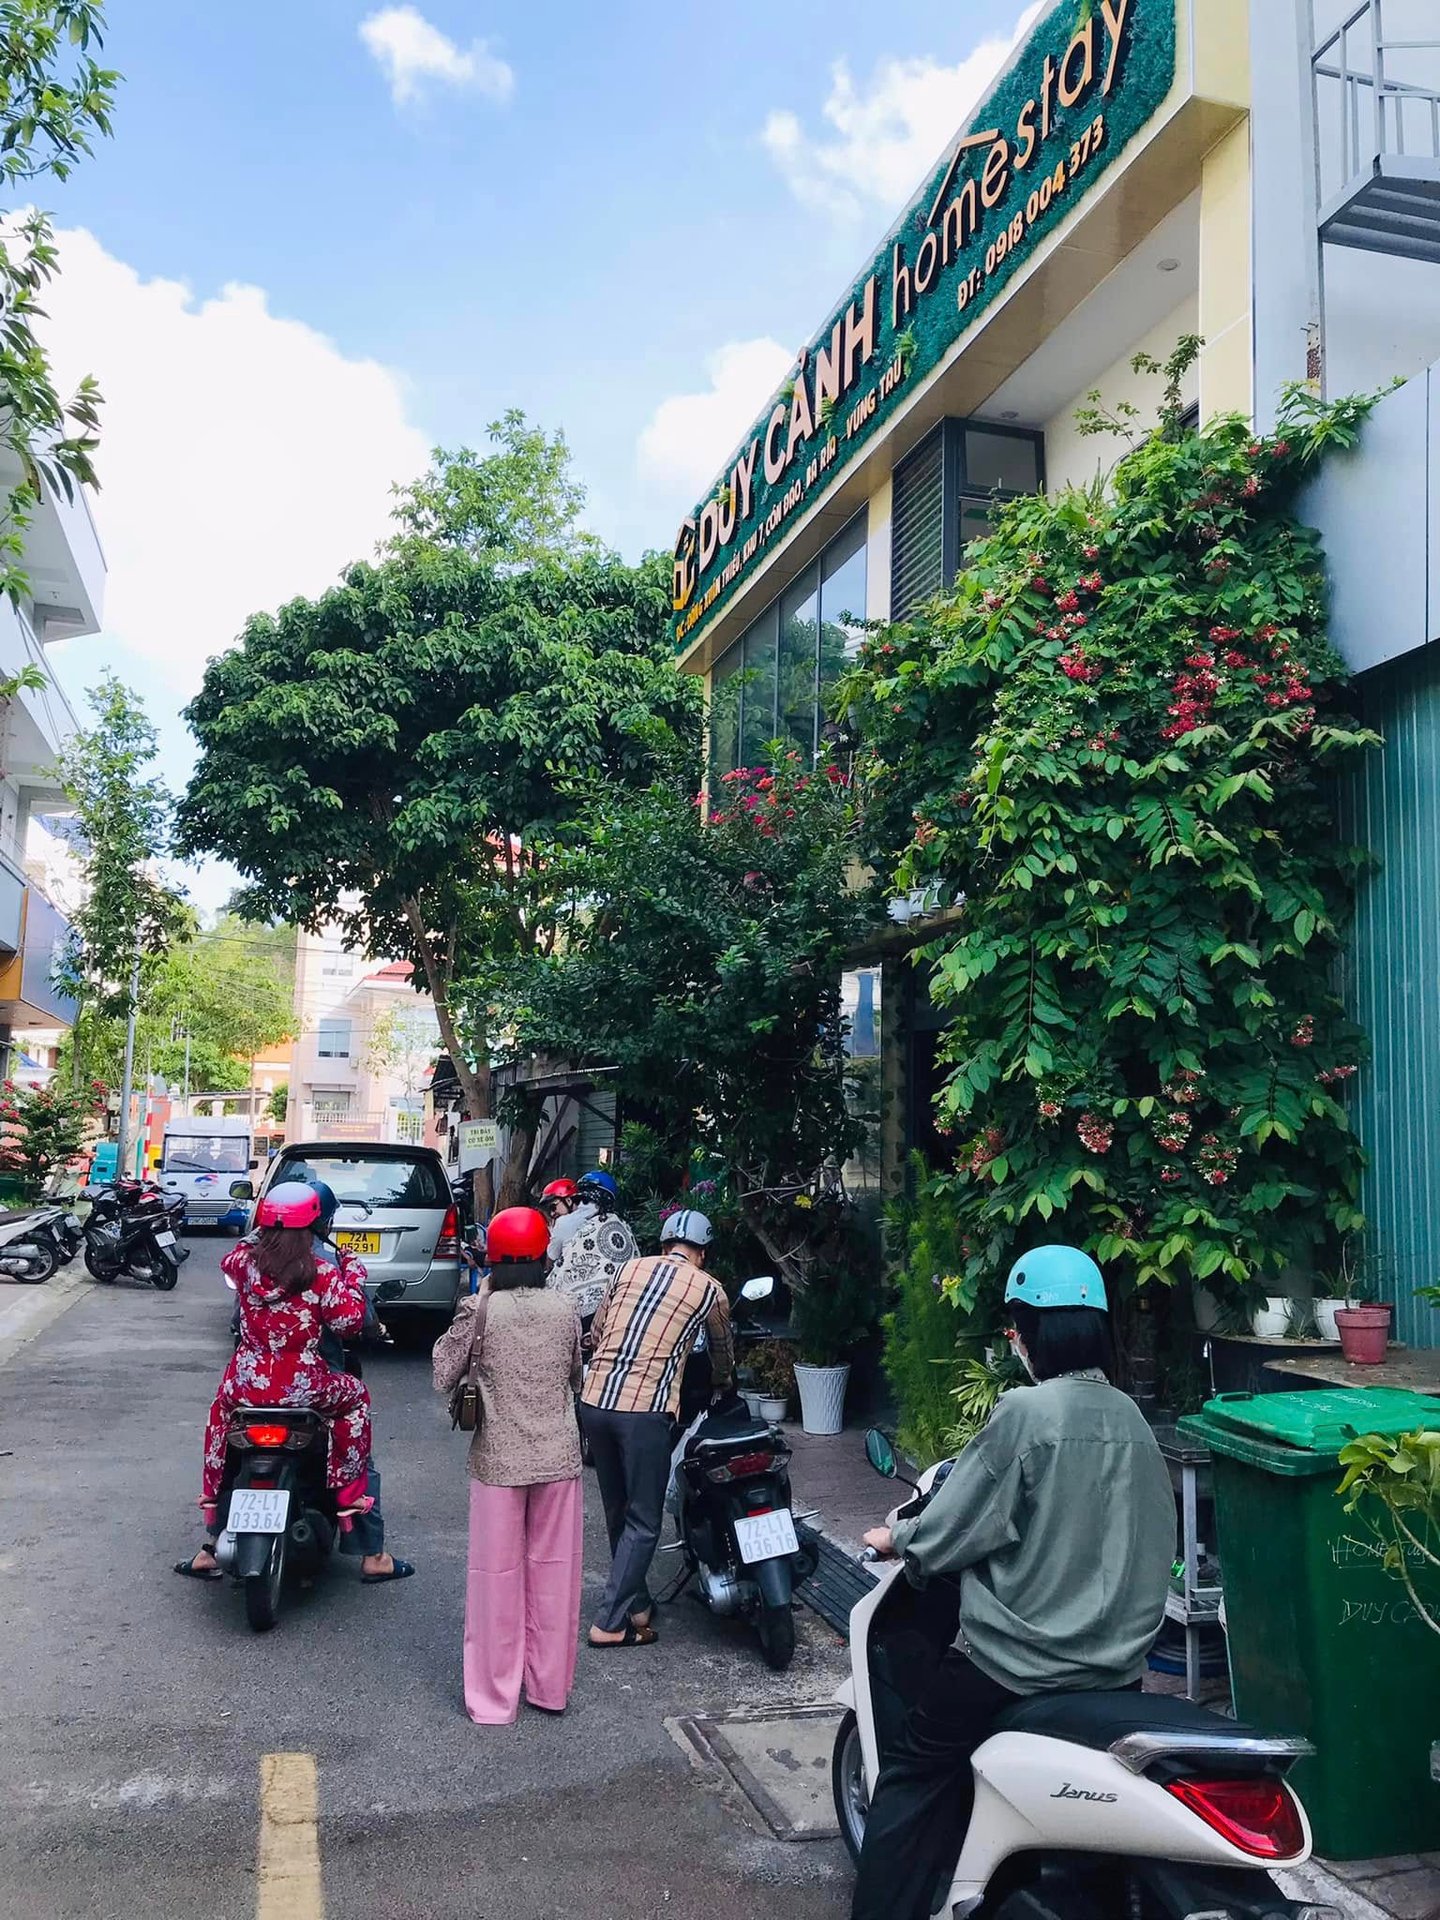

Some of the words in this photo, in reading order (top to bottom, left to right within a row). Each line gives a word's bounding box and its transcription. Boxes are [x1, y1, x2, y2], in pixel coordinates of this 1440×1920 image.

[985, 211, 1024, 276] 0918
[1026, 161, 1066, 225] 004
[1069, 114, 1104, 177] 373
[700, 437, 760, 574] DUY
[763, 274, 877, 486] CẢNH
[892, 0, 1128, 329] homestay
[349, 1232, 368, 1243] 72A
[240, 1493, 280, 1511] 72-L1
[231, 1511, 282, 1530] 033.64
[1050, 1782, 1118, 1803] Janus
